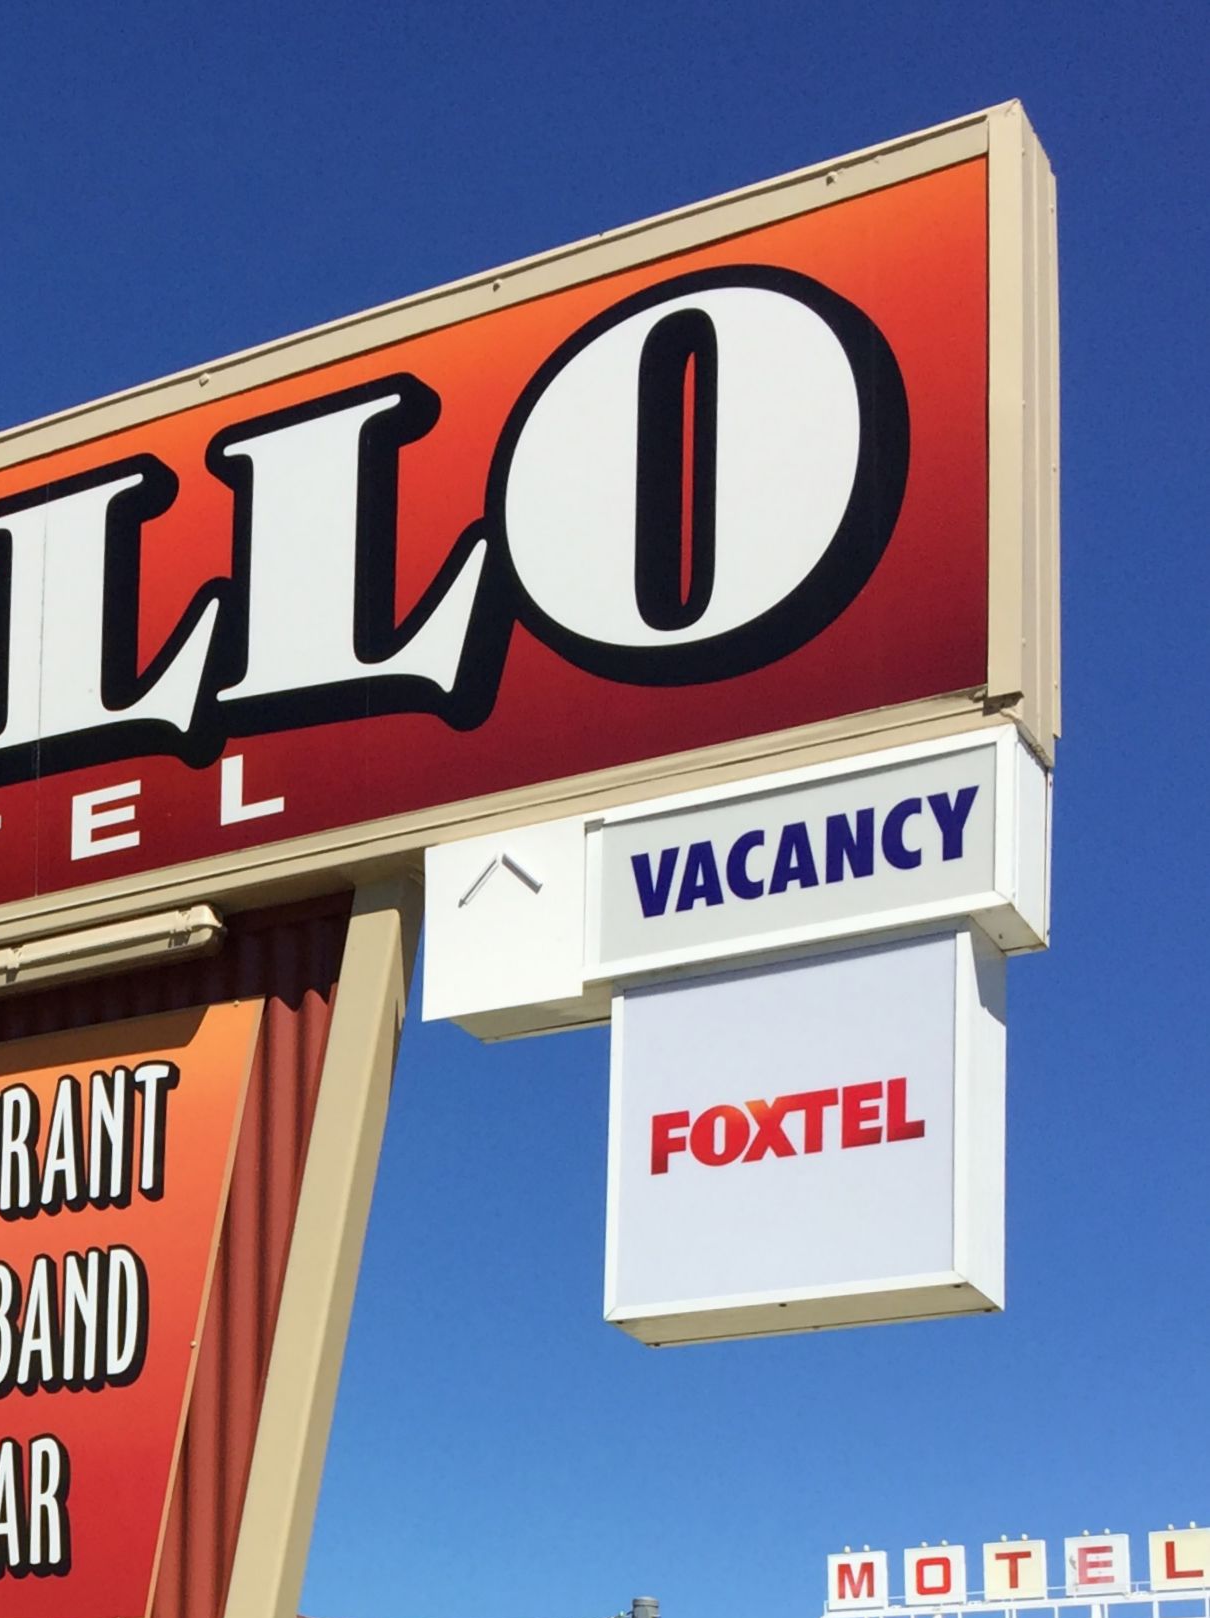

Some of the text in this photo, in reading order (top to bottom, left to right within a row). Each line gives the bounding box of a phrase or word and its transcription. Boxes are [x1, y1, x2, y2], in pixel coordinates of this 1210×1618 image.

[630, 785, 980, 919] VACANCY
[650, 1076, 926, 1176] FOXTEL
[837, 1540, 1204, 1600] MOTEL
